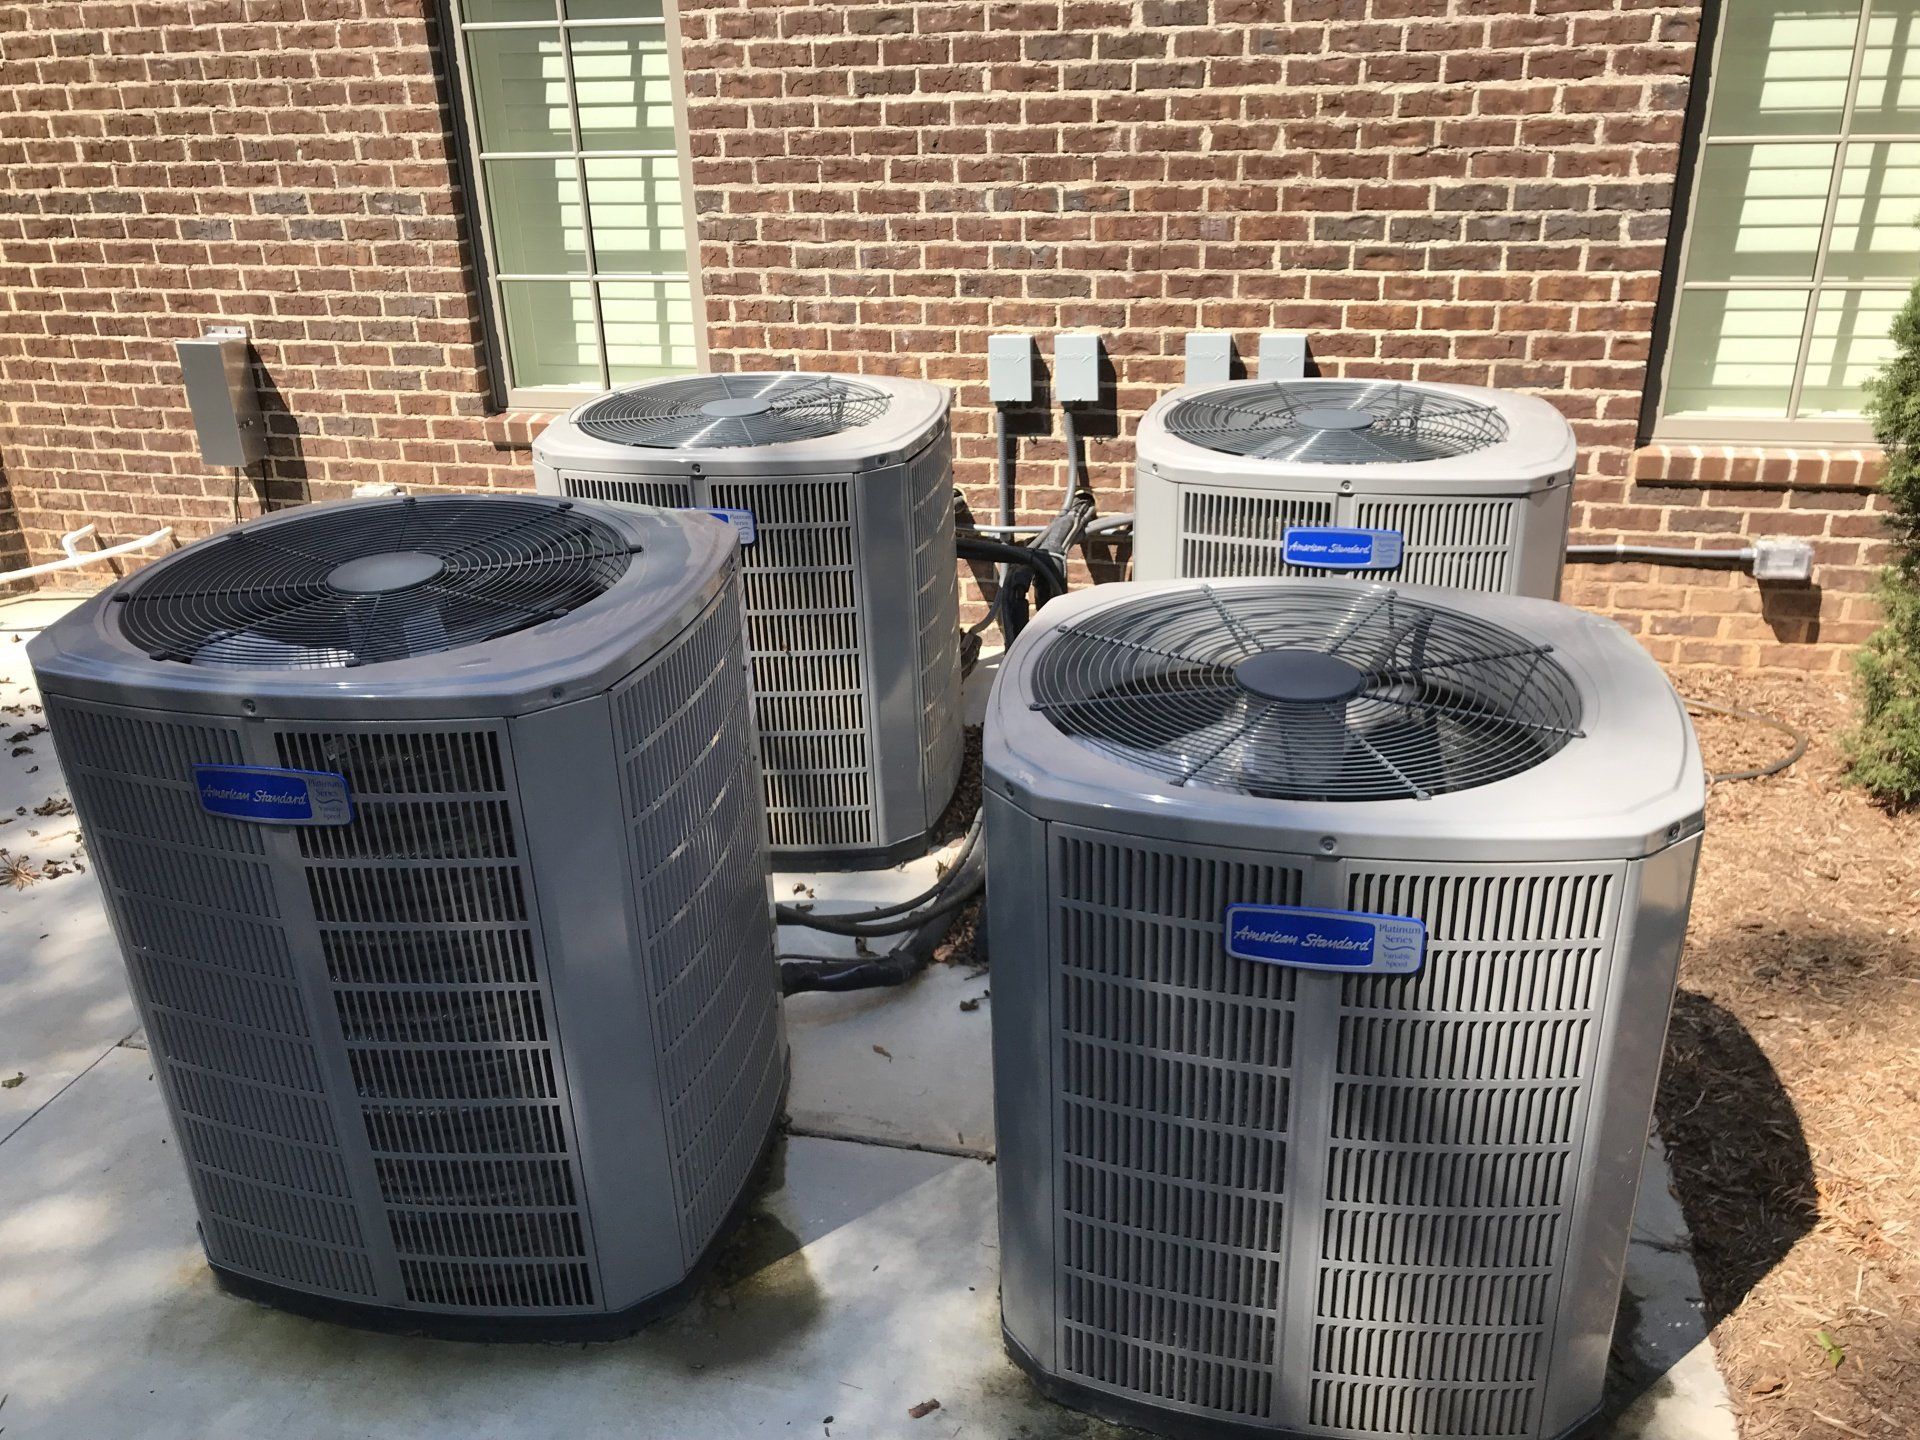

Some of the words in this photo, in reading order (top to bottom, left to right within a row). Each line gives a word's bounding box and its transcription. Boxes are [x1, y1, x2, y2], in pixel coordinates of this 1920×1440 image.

[1289, 541, 1327, 553] American
[1328, 543, 1371, 554] Standard
[202, 784, 250, 801] American
[253, 790, 306, 805] Standard
[1379, 923, 1421, 935] Platinum
[1234, 925, 1298, 945] American
[1301, 933, 1372, 951] Standard
[1385, 934, 1413, 944] Series
